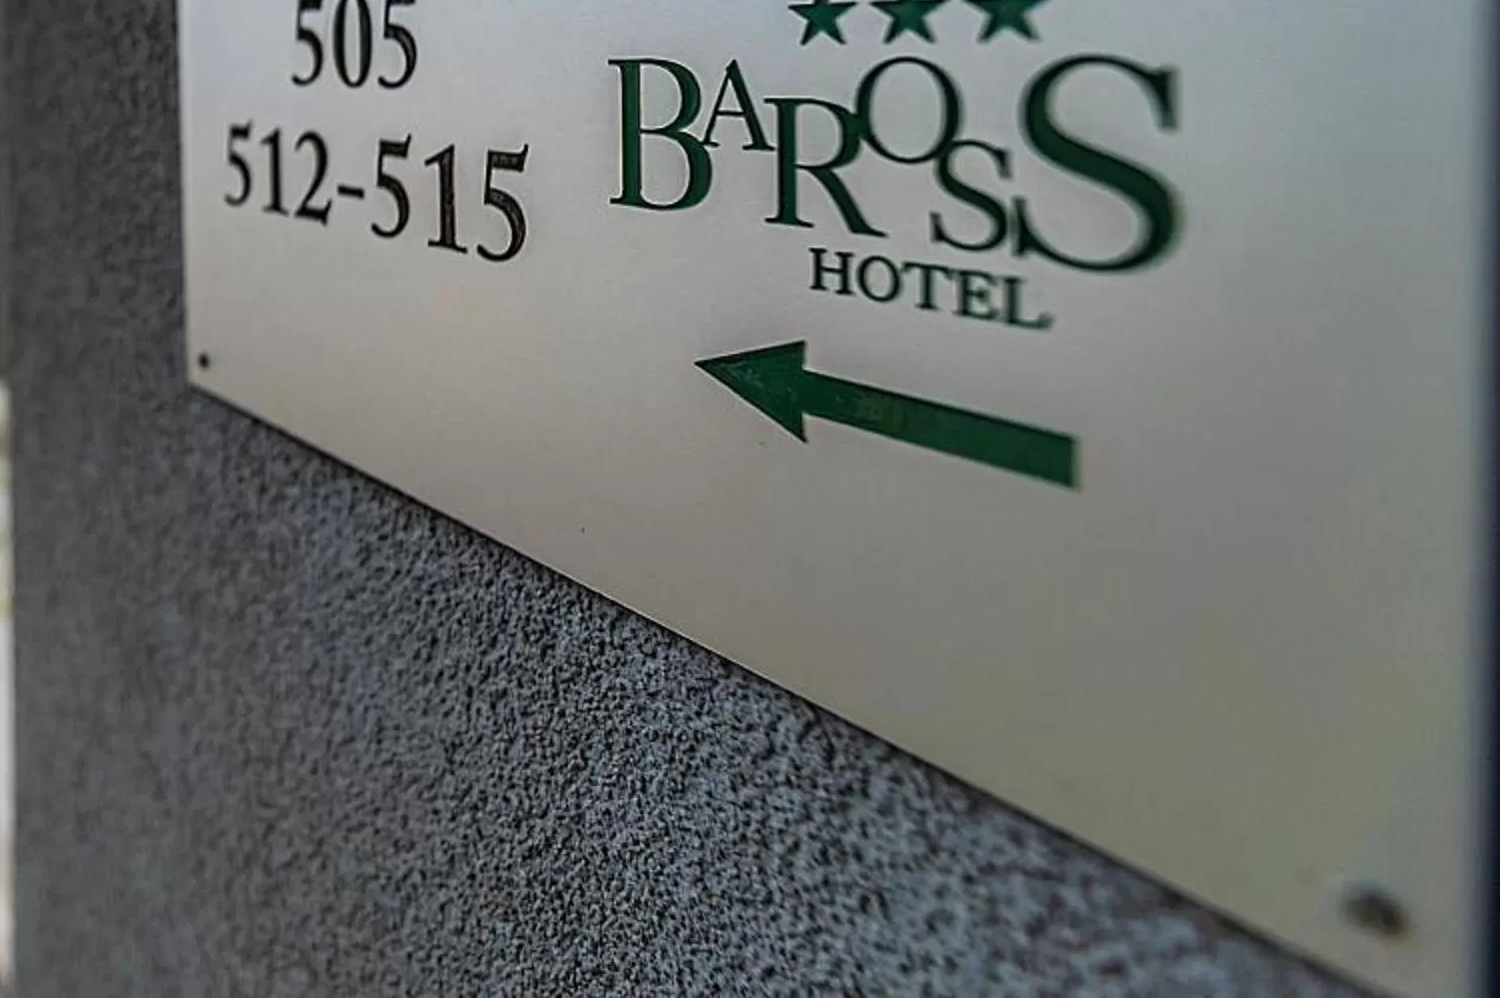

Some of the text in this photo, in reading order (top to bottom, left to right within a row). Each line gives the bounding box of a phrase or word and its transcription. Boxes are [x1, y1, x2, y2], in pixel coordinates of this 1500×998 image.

[223, 120, 530, 263] 512-515
[607, 54, 1186, 275] BAROSS
[808, 248, 1054, 331] HOTEL
